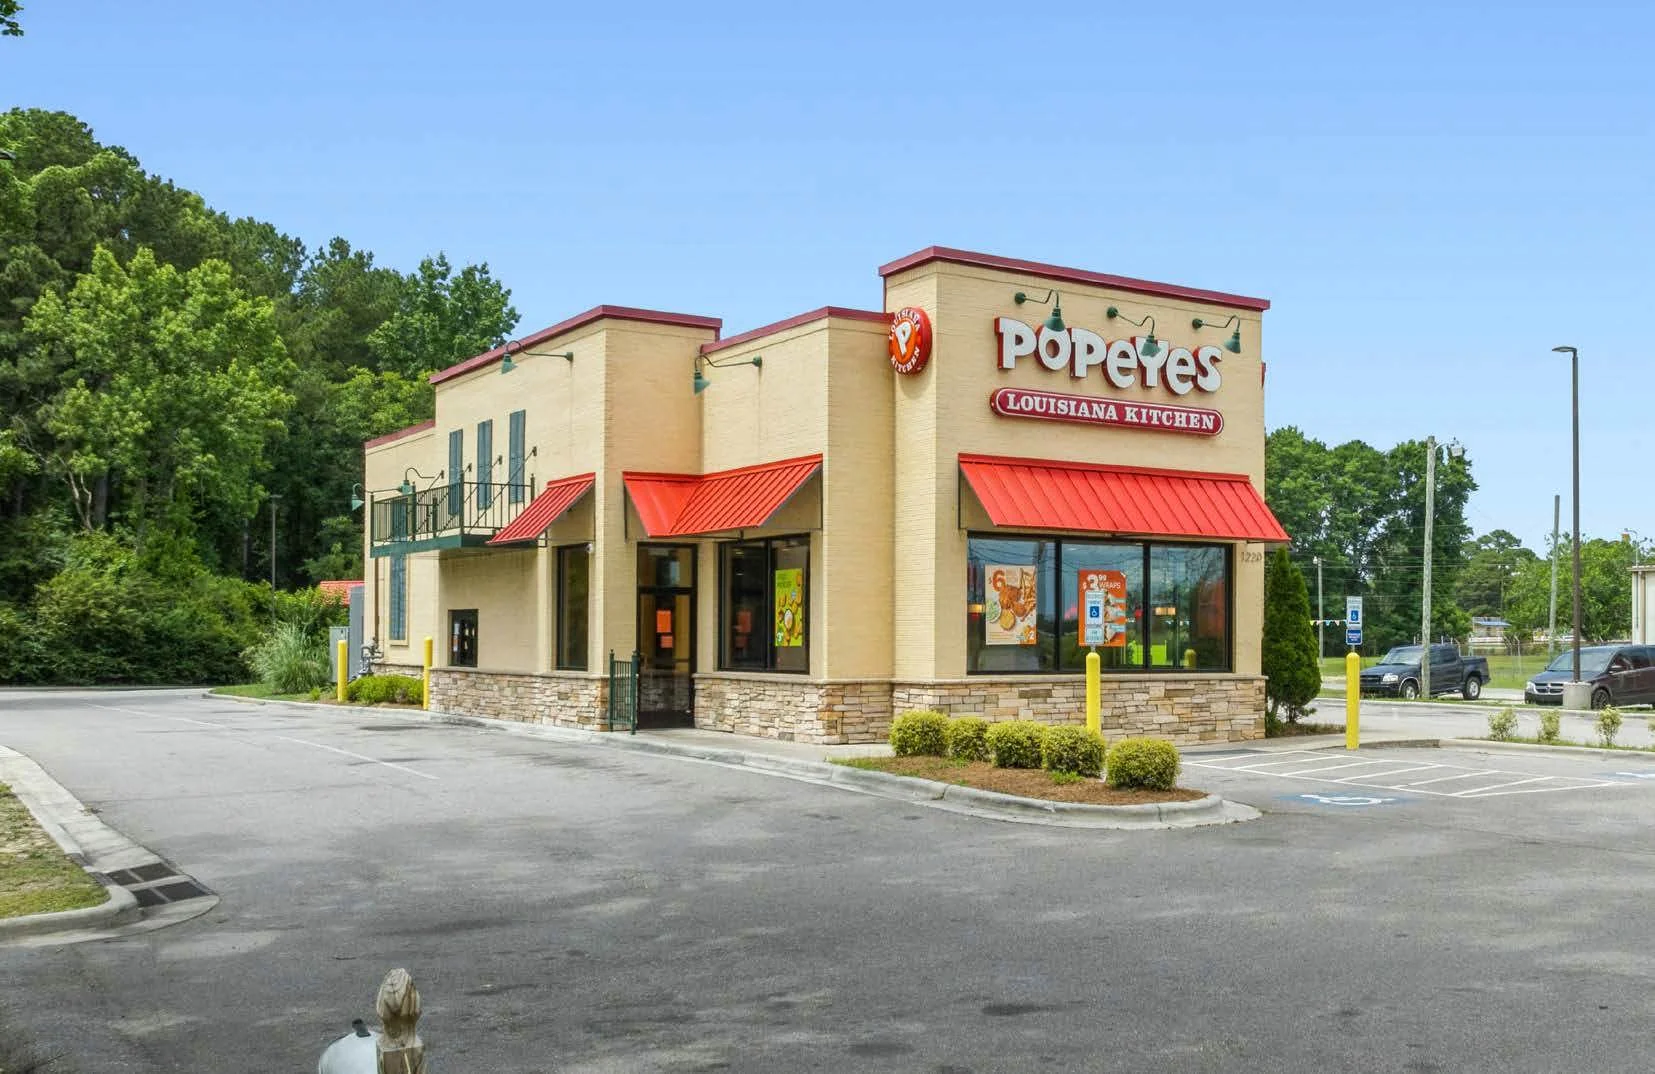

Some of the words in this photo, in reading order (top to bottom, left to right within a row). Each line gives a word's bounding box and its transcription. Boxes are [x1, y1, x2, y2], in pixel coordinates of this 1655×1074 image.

[895, 321, 911, 356] P
[891, 346, 920, 373] KITCHEN
[1007, 393, 1118, 420] LOUISIANA
[1124, 407, 1215, 430] KITCHEN
[1240, 551, 1262, 562] 1220
